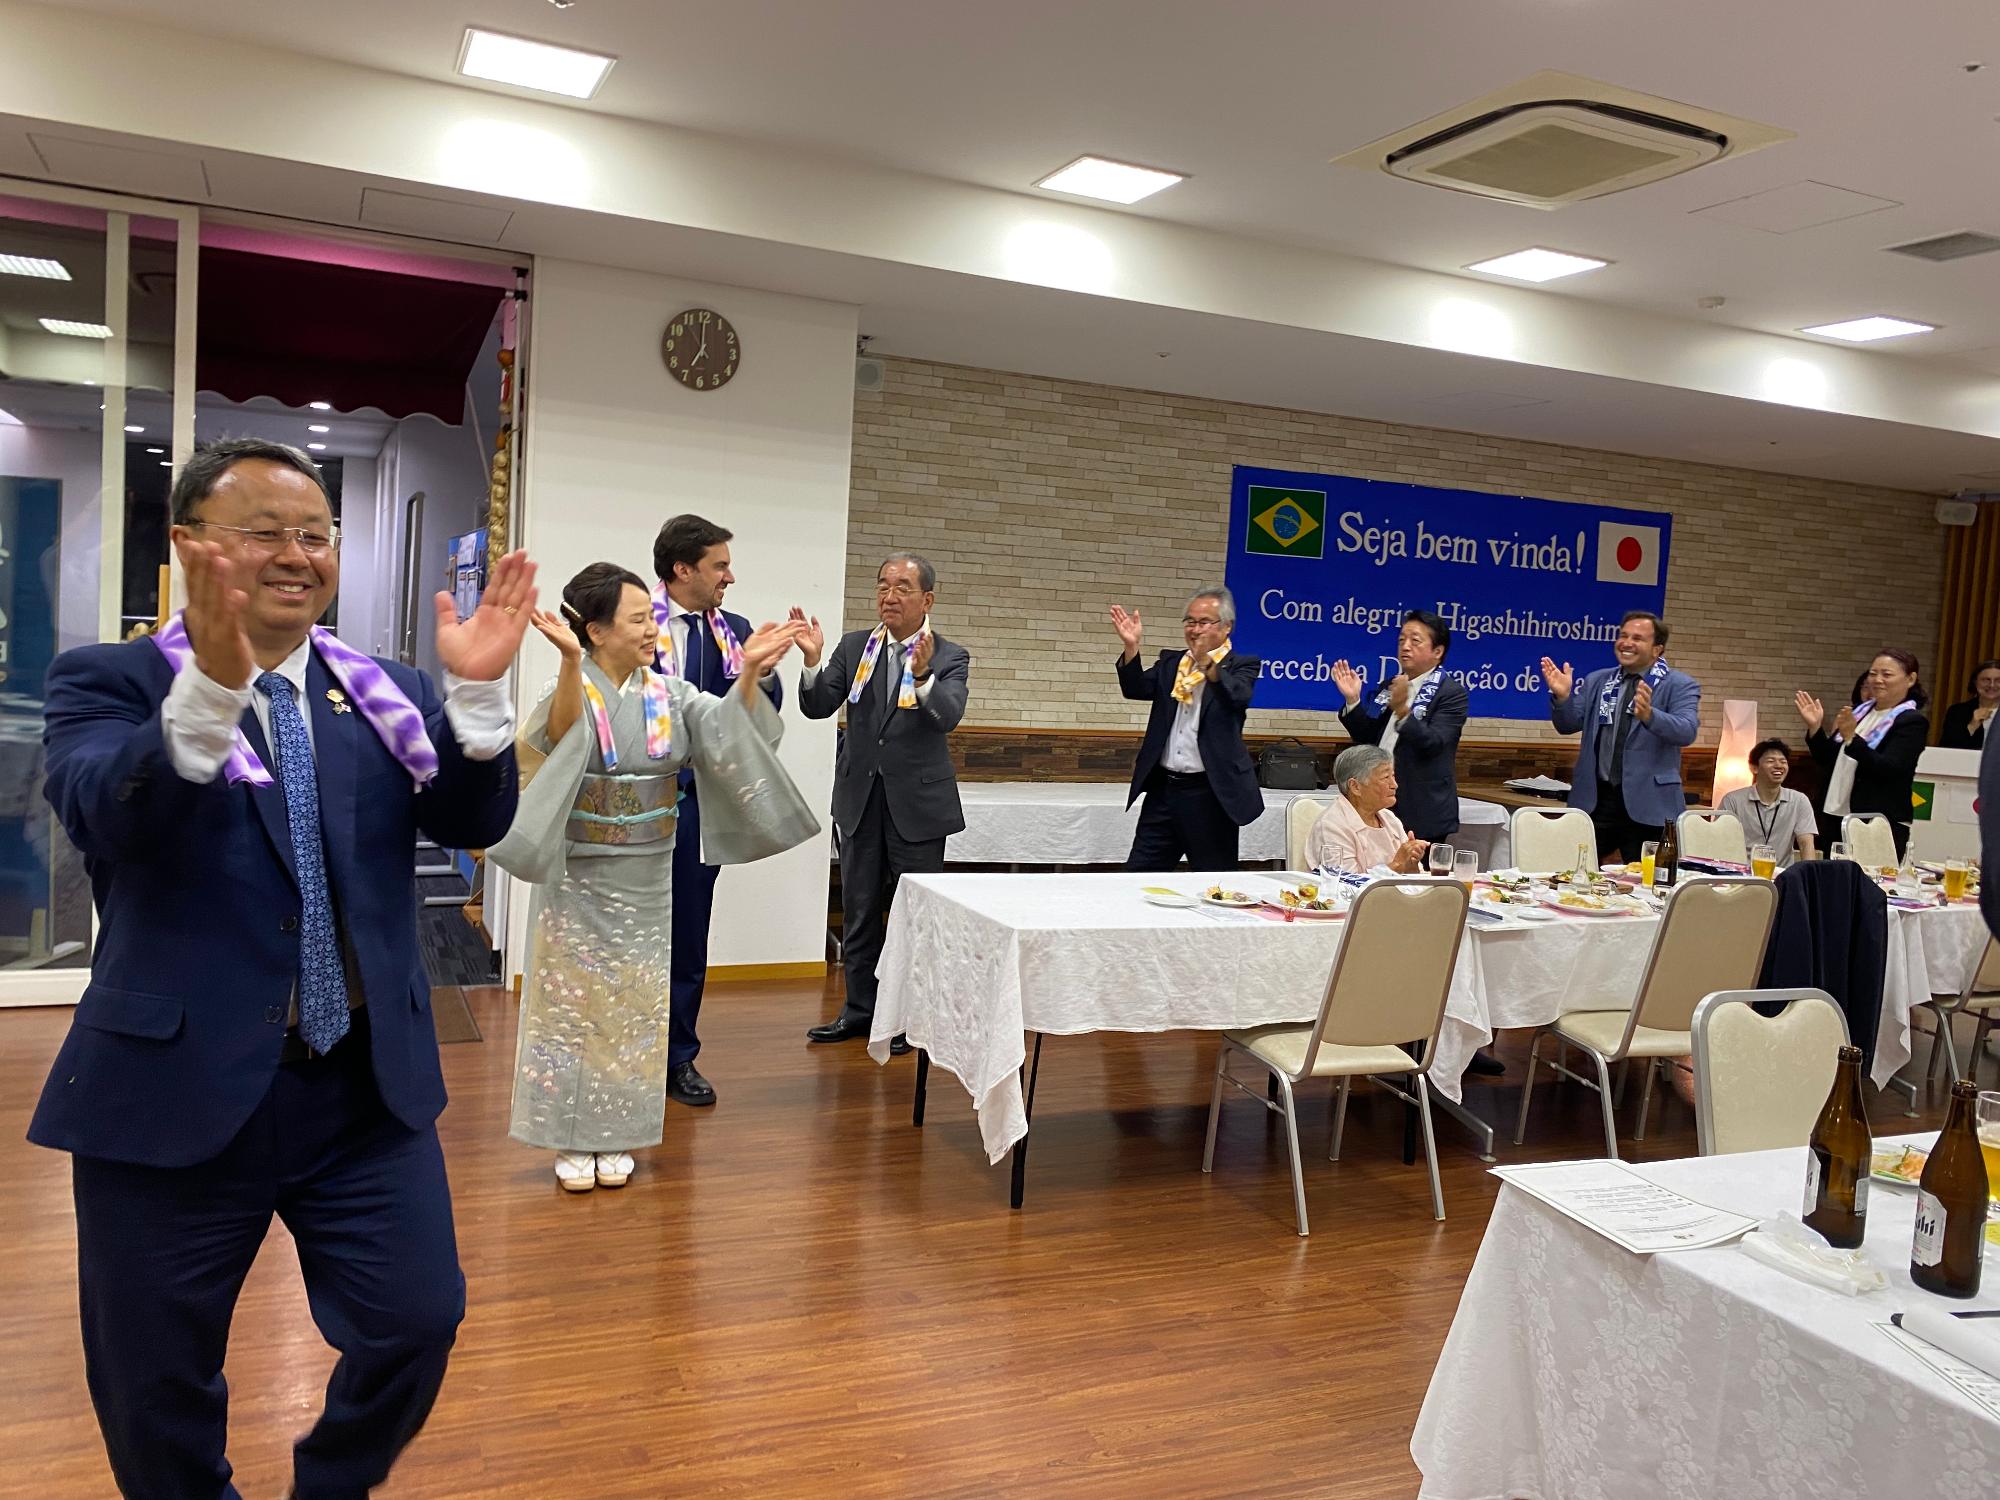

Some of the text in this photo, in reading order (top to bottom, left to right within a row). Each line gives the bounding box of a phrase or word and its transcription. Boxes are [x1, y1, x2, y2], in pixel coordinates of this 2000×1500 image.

[683, 313, 694, 325] 11
[699, 311, 711, 324] 12
[671, 323, 684, 337] 10
[717, 318, 723, 331] 1
[727, 331, 735, 344] 2
[666, 339, 674, 352] 9
[729, 348, 737, 361] 3
[670, 356, 678, 368] 8
[681, 369, 689, 382] 7
[724, 364, 732, 376] 4
[696, 375, 704, 388] 6
[712, 373, 720, 386] 5
[1337, 511, 1586, 574] Seja bem vinda!
[1260, 589, 1622, 642] Com alegri Higashihiroshim
[1514, 666, 1540, 693] de
